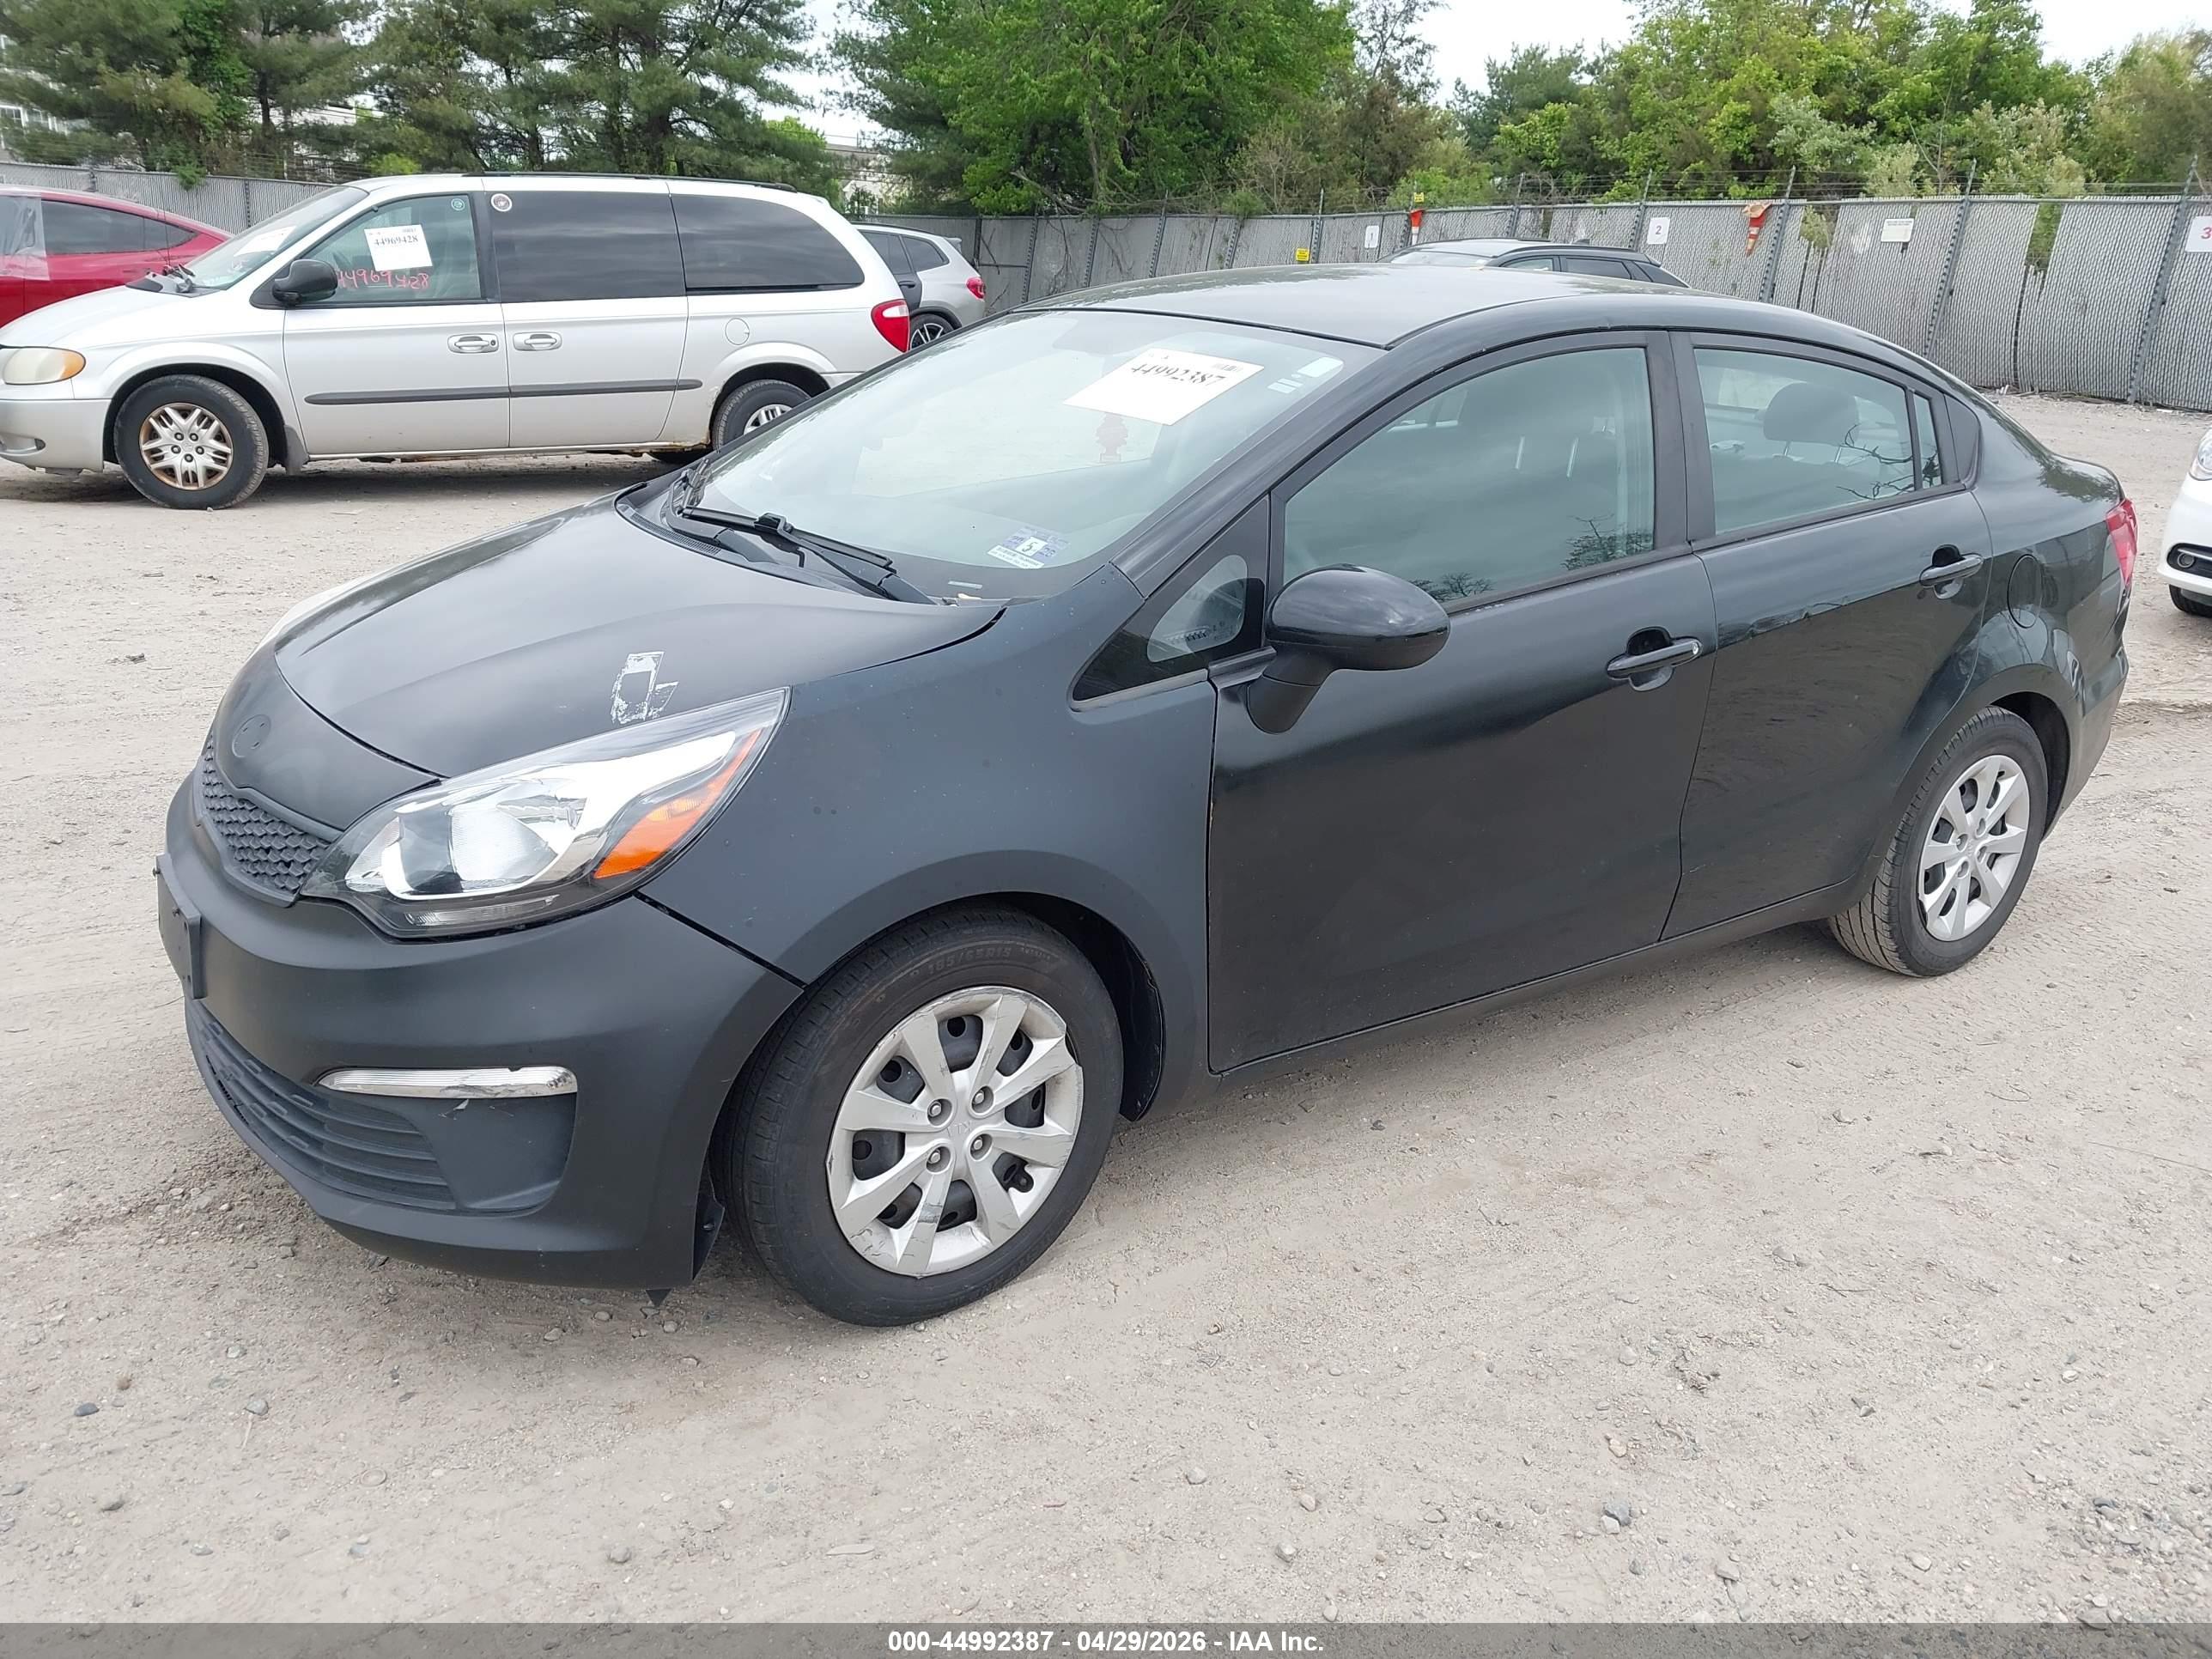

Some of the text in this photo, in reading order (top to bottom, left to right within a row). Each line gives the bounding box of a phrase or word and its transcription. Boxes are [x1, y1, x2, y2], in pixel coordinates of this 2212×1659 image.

[1656, 225, 1662, 234] 2
[2201, 227, 2212, 239] 3
[374, 234, 419, 246] 44969428
[1130, 363, 1226, 386] 44992387
[1022, 541, 1039, 552] 5
